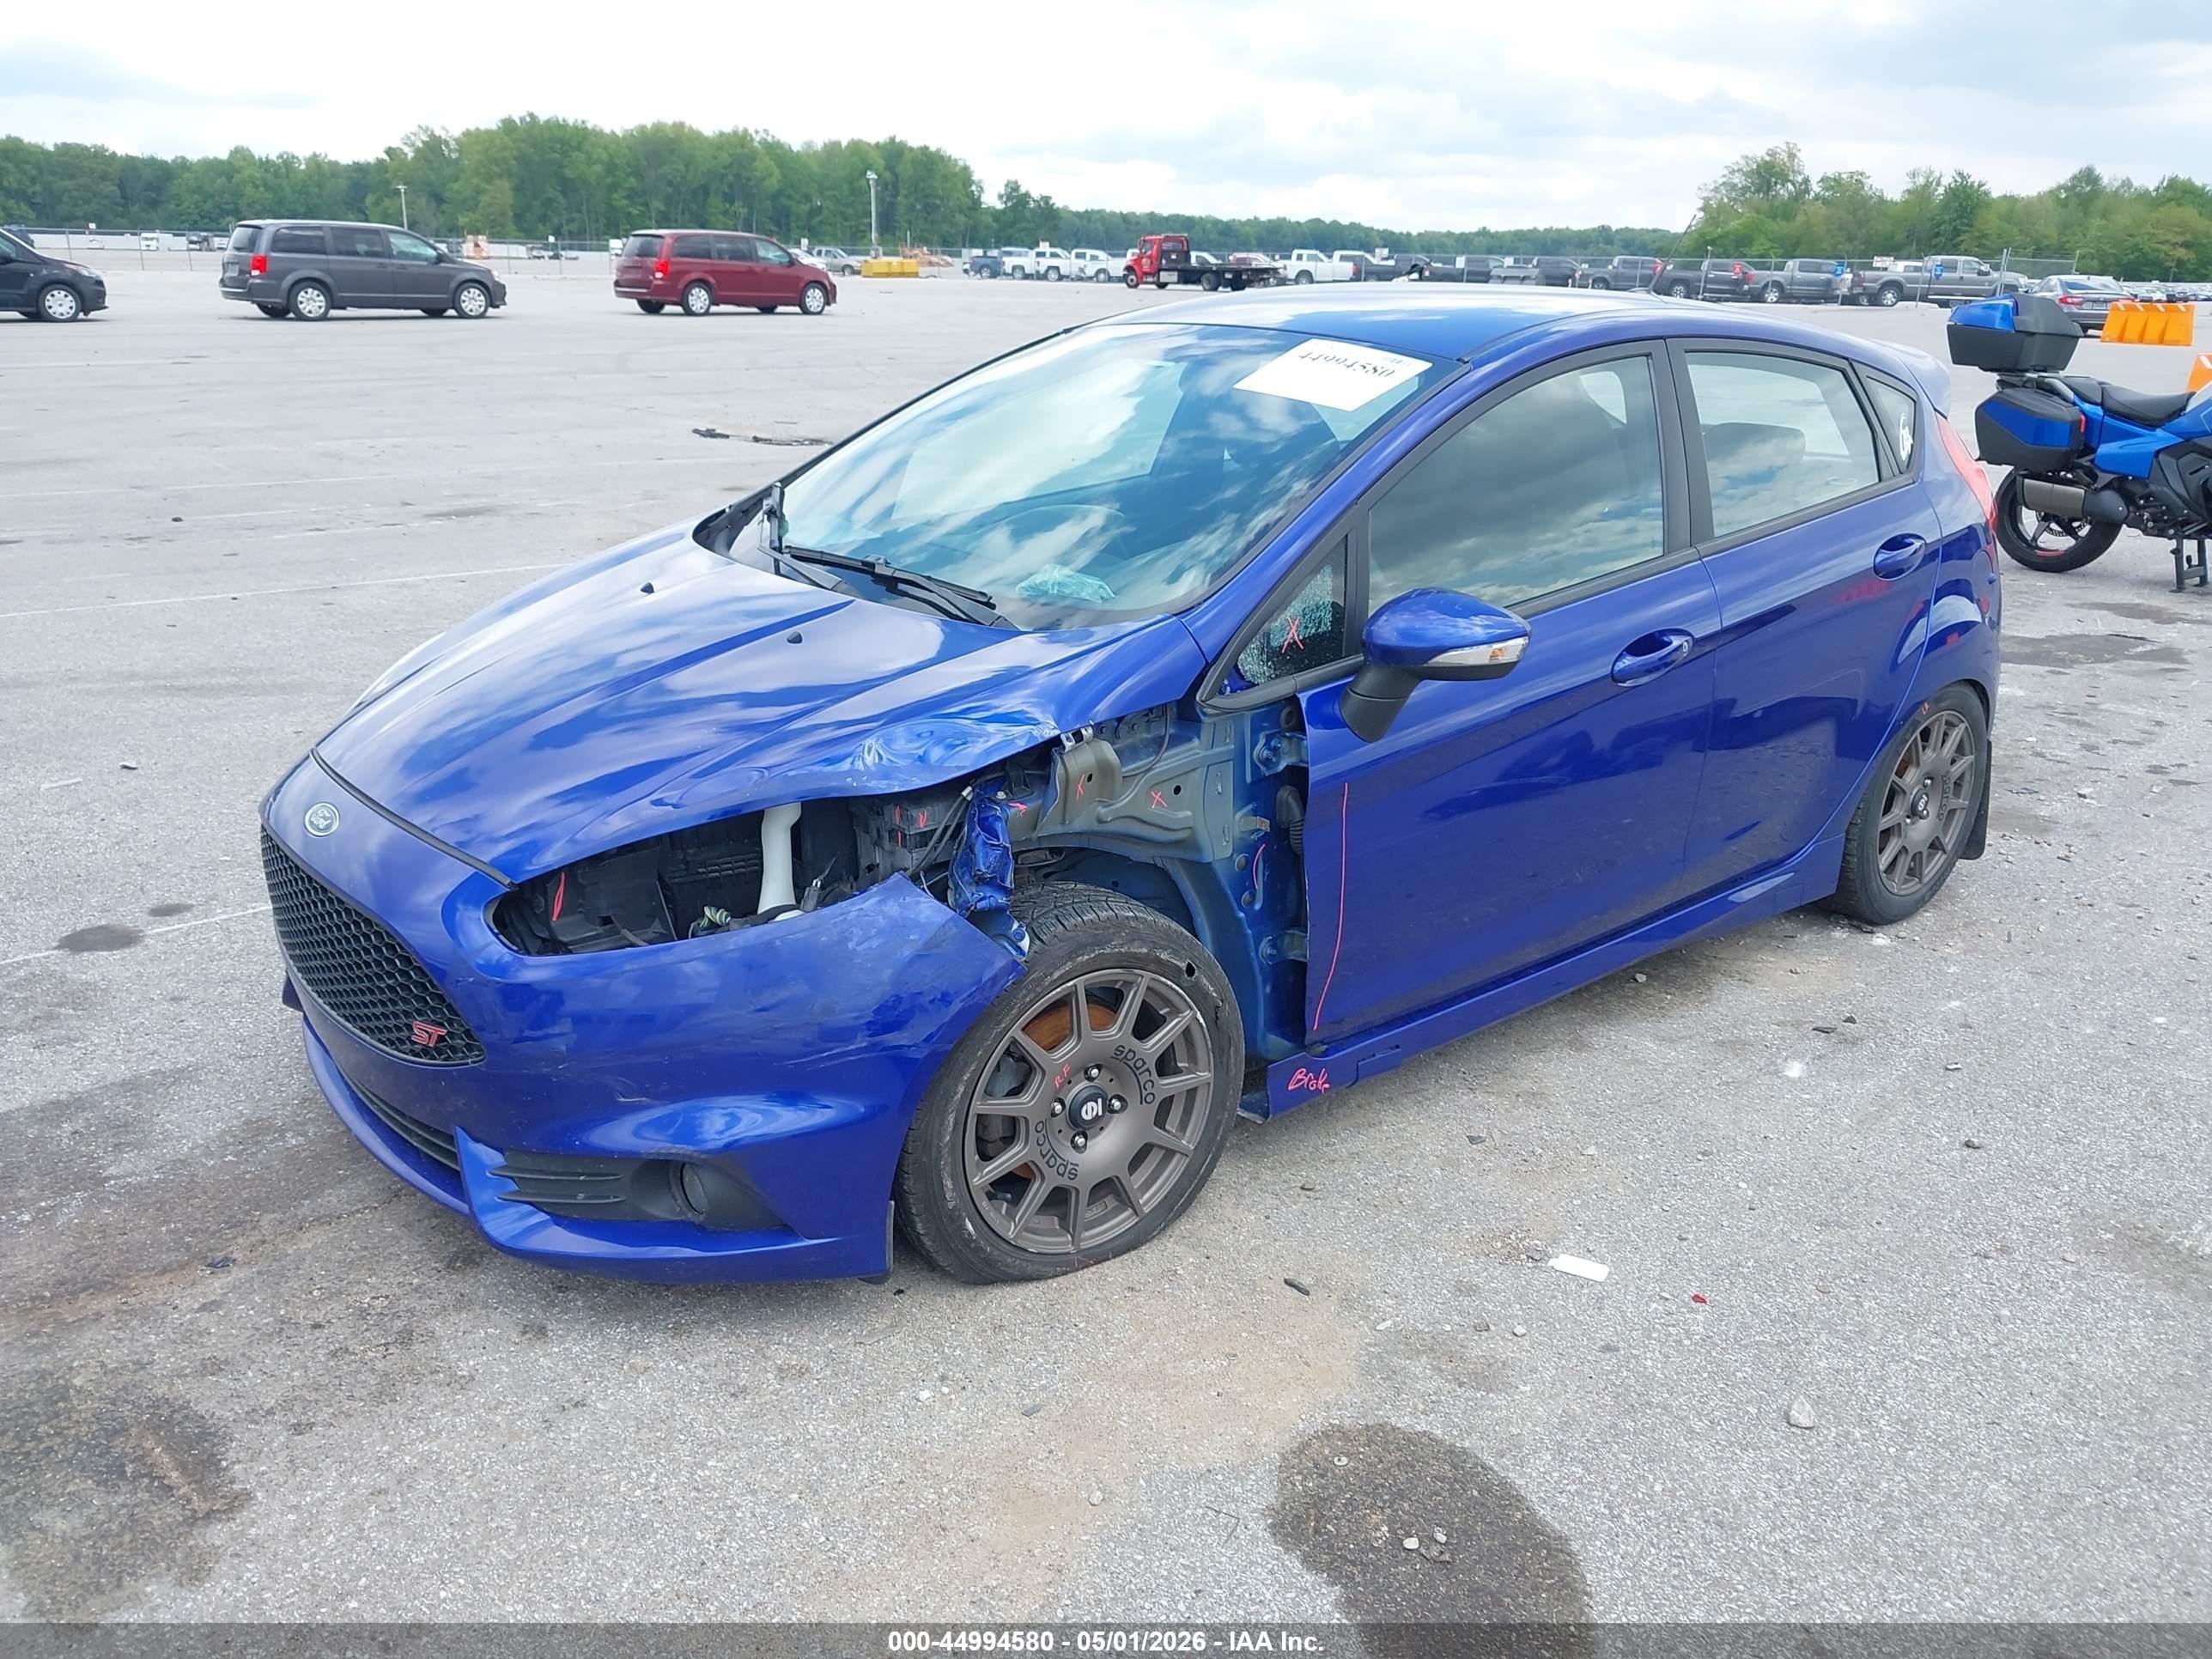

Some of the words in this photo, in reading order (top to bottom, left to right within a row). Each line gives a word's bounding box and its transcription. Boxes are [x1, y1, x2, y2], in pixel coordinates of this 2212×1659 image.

[411, 1021, 447, 1047] ST
[1111, 1044, 1156, 1105] sparco
[1035, 1120, 1079, 1181] sparco
